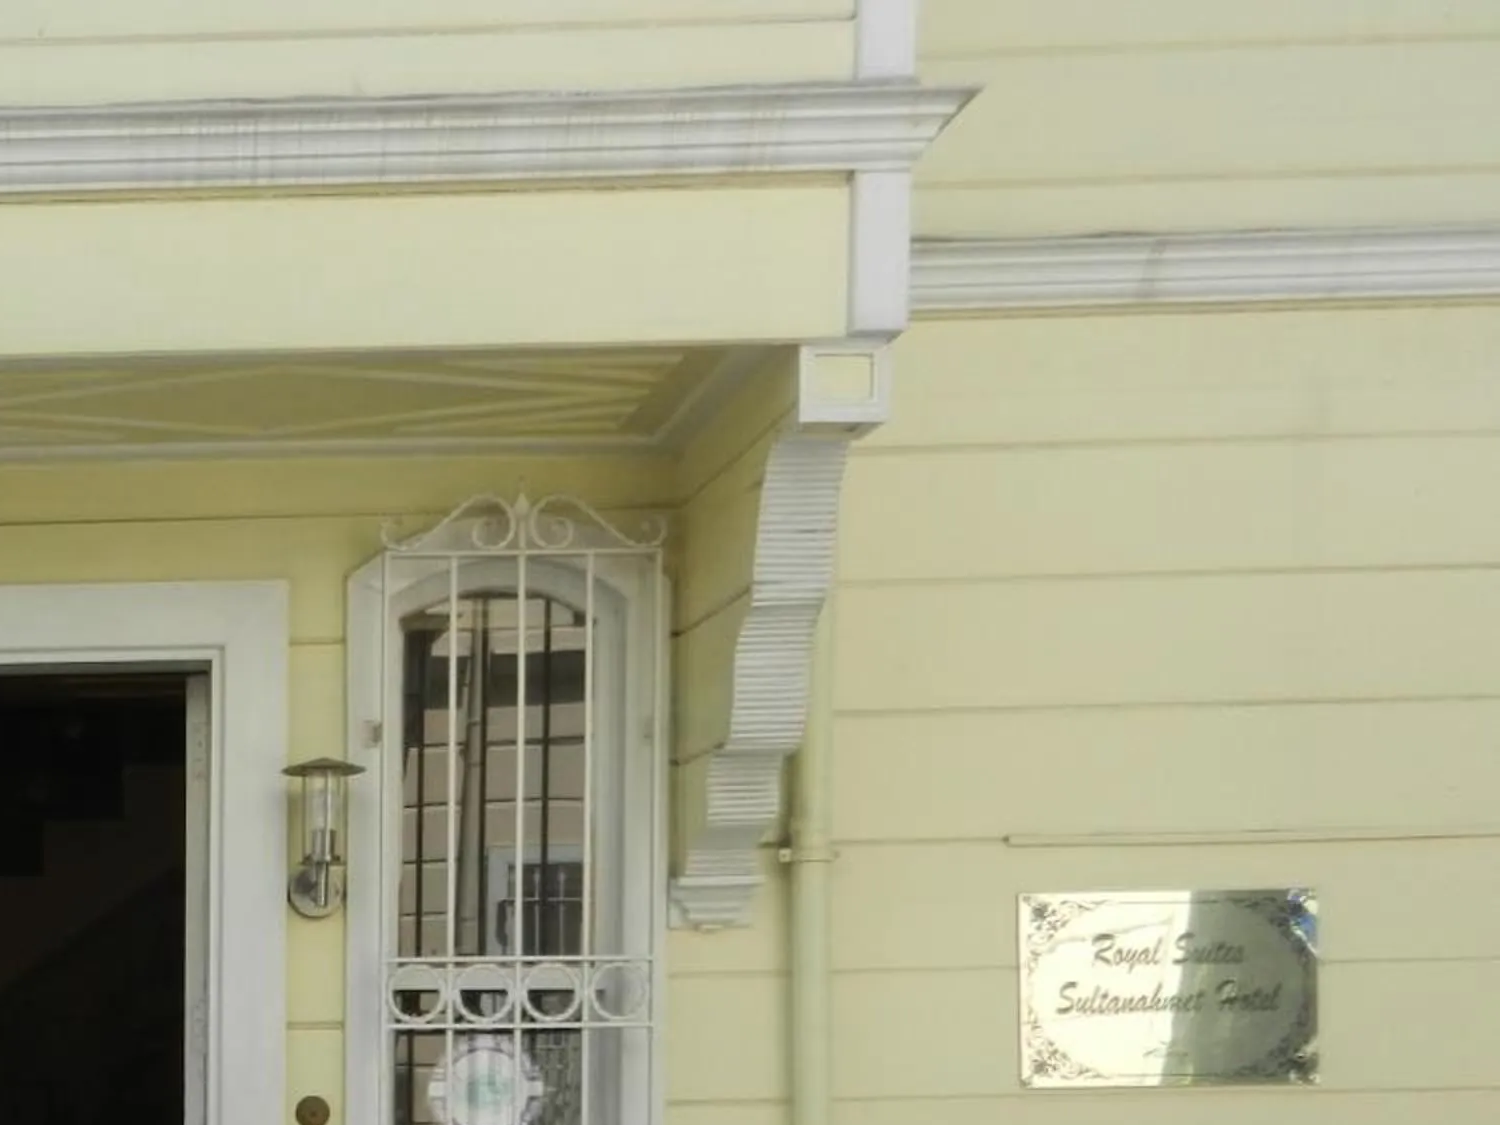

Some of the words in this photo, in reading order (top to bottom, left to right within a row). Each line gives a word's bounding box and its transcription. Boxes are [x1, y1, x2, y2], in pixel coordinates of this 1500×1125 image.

[1092, 932, 1164, 974] Royal
[1172, 931, 1245, 965] Suites
[1056, 980, 1205, 1016] Sultanahmet
[1214, 978, 1283, 1013] Hotel
